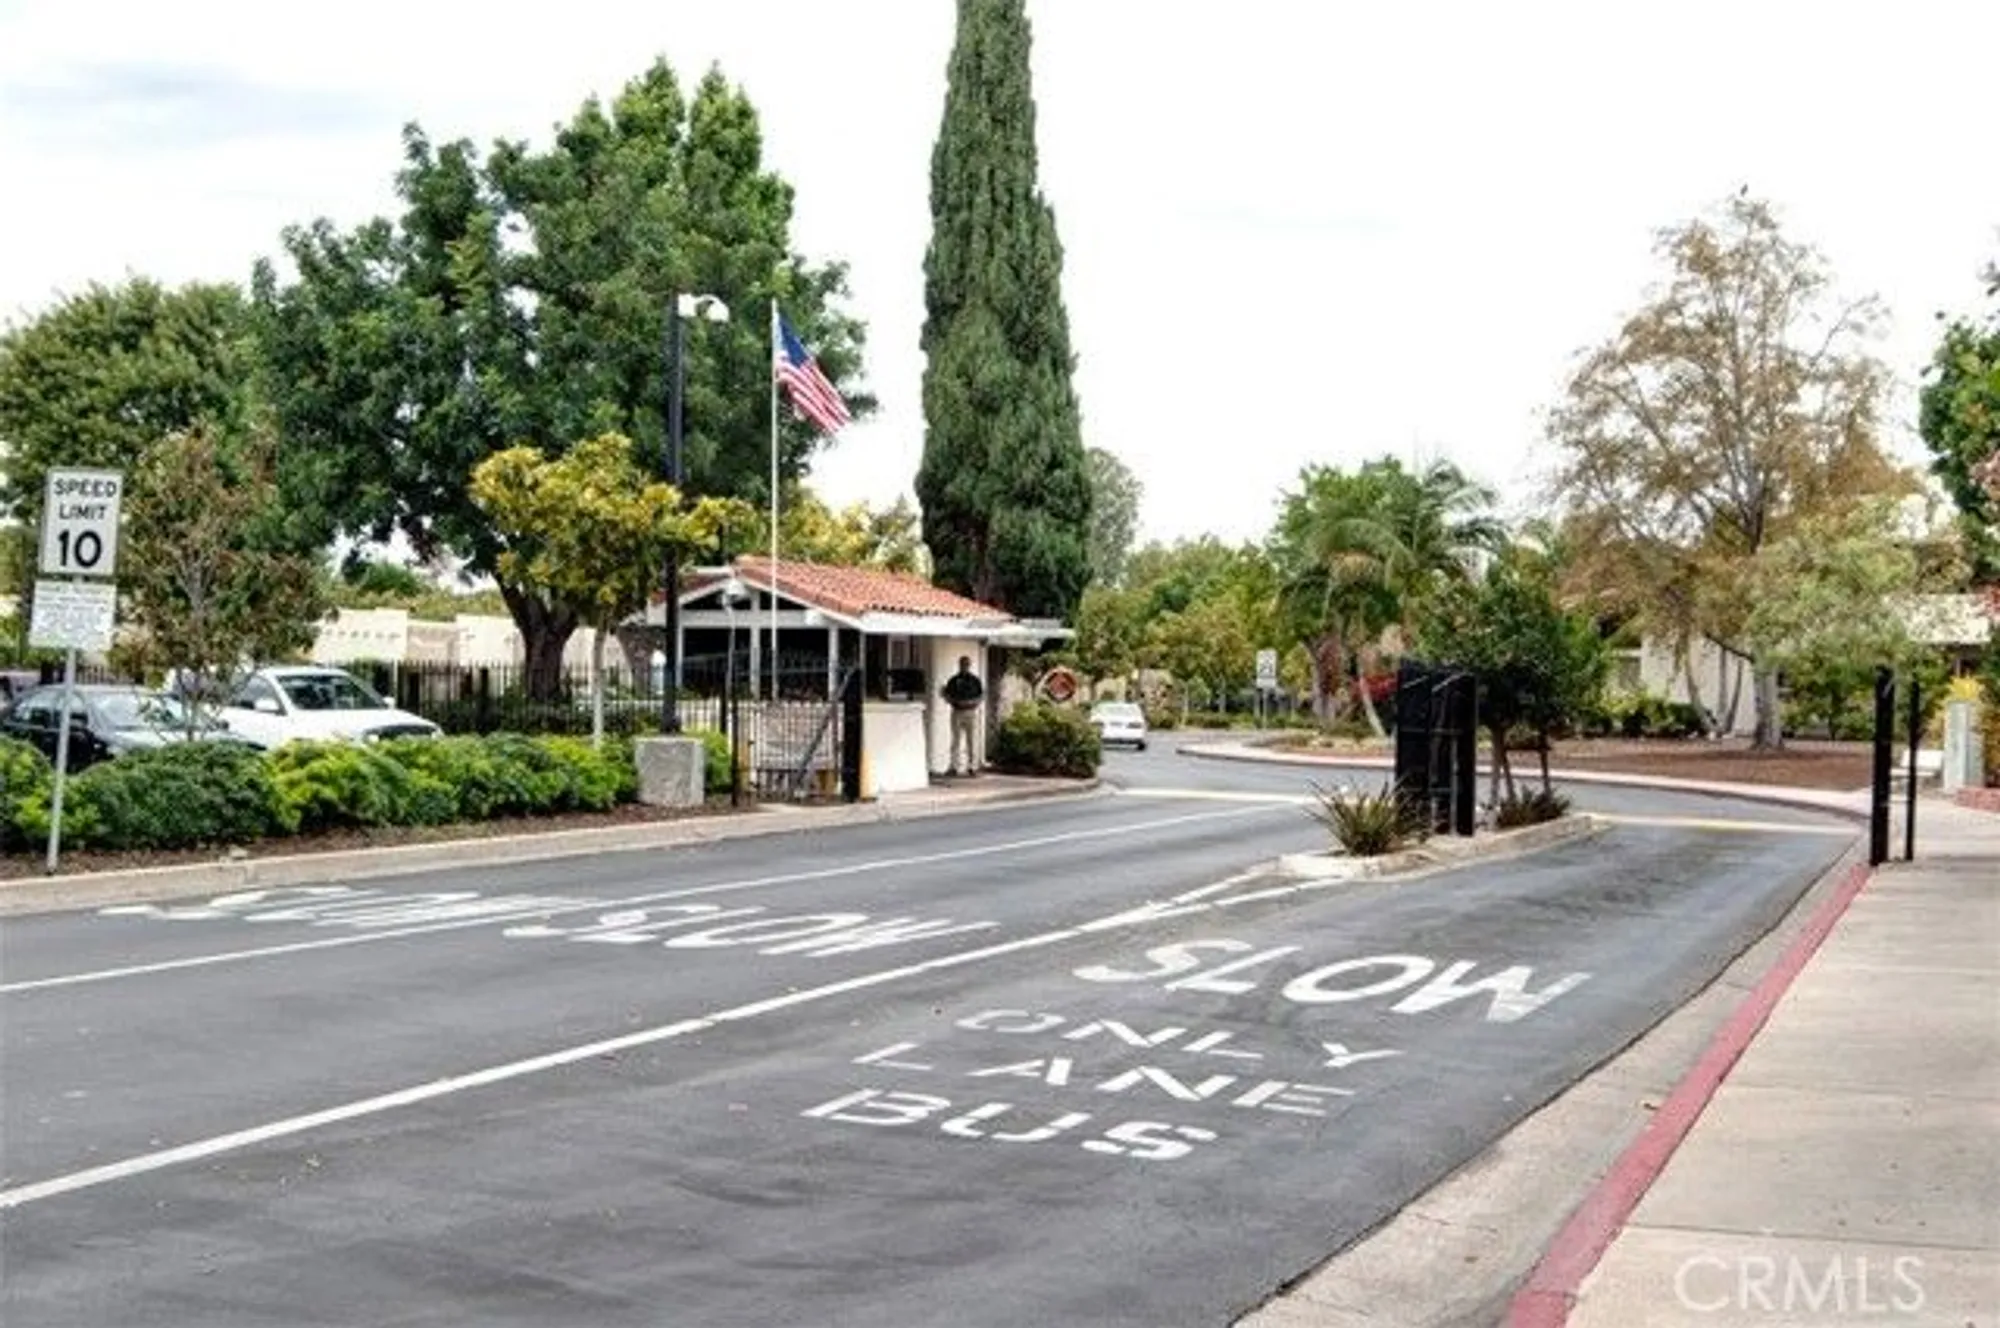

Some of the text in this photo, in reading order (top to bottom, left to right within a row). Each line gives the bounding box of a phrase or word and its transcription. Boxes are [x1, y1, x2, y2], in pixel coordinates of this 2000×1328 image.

[54, 479, 117, 497] SPEED
[59, 504, 106, 520] LIMIT
[58, 529, 102, 568] 10
[502, 904, 1001, 957] SLOW
[1073, 939, 1593, 1022] SLOW
[955, 1008, 1404, 1068] ONLY
[851, 1042, 1355, 1117] LANE
[801, 1088, 1217, 1160] BUS
